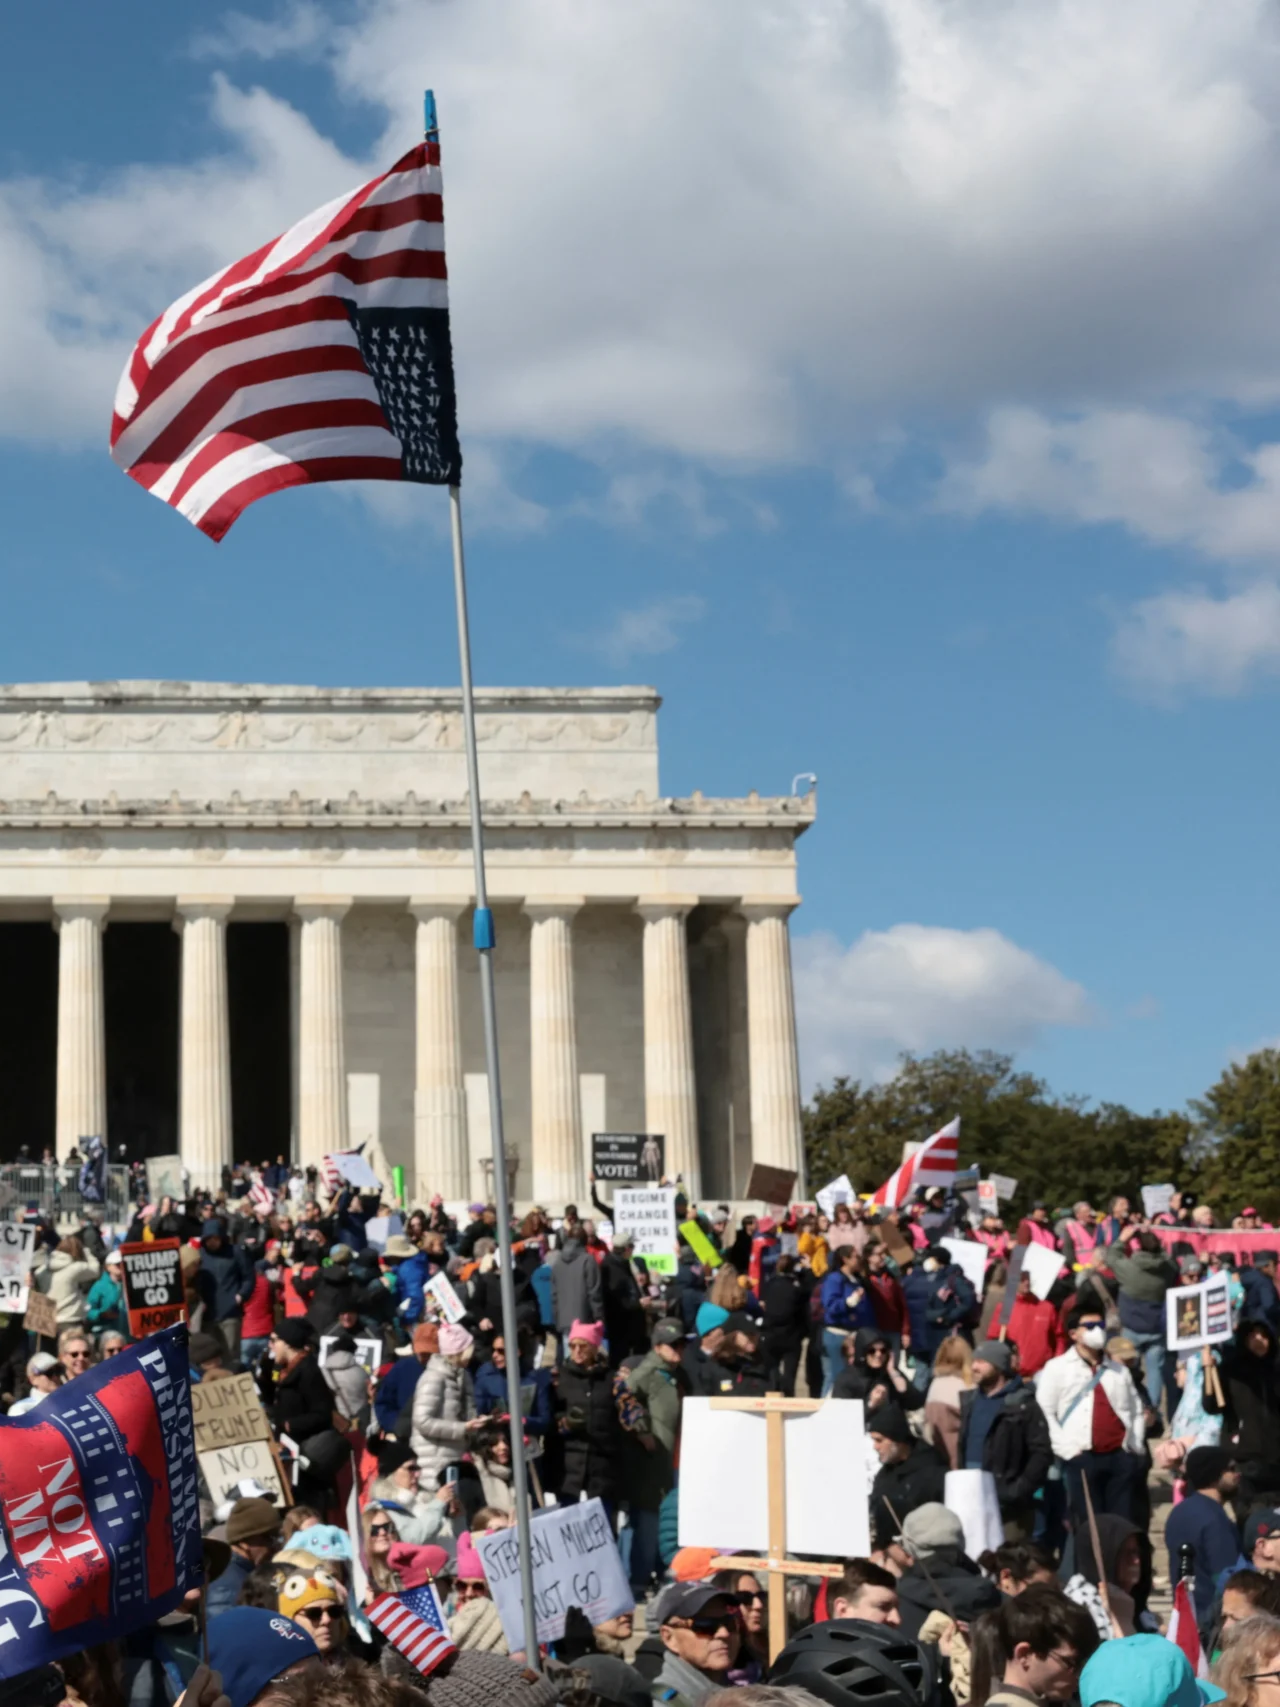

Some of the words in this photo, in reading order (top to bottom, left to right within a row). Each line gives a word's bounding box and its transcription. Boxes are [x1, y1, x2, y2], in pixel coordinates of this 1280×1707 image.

[595, 1164, 638, 1178] VOTE!
[621, 1192, 667, 1204] REGIME
[619, 1209, 669, 1221] CHANGE
[123, 1249, 179, 1272] TRUMP
[640, 1243, 655, 1254] AT
[131, 1267, 176, 1289] MUST
[143, 1286, 169, 1306] GO
[173, 1377, 194, 1463] NOT
[193, 1408, 261, 1442] TRUMP
[216, 1445, 259, 1475] NO
[38, 1453, 105, 1565] NOT
[183, 1472, 199, 1532] MY
[5, 1487, 63, 1569] MY
[483, 1529, 555, 1582] STEPEN
[560, 1512, 608, 1558] MILLER
[521, 1580, 565, 1623] UST
[573, 1571, 602, 1605] GO
